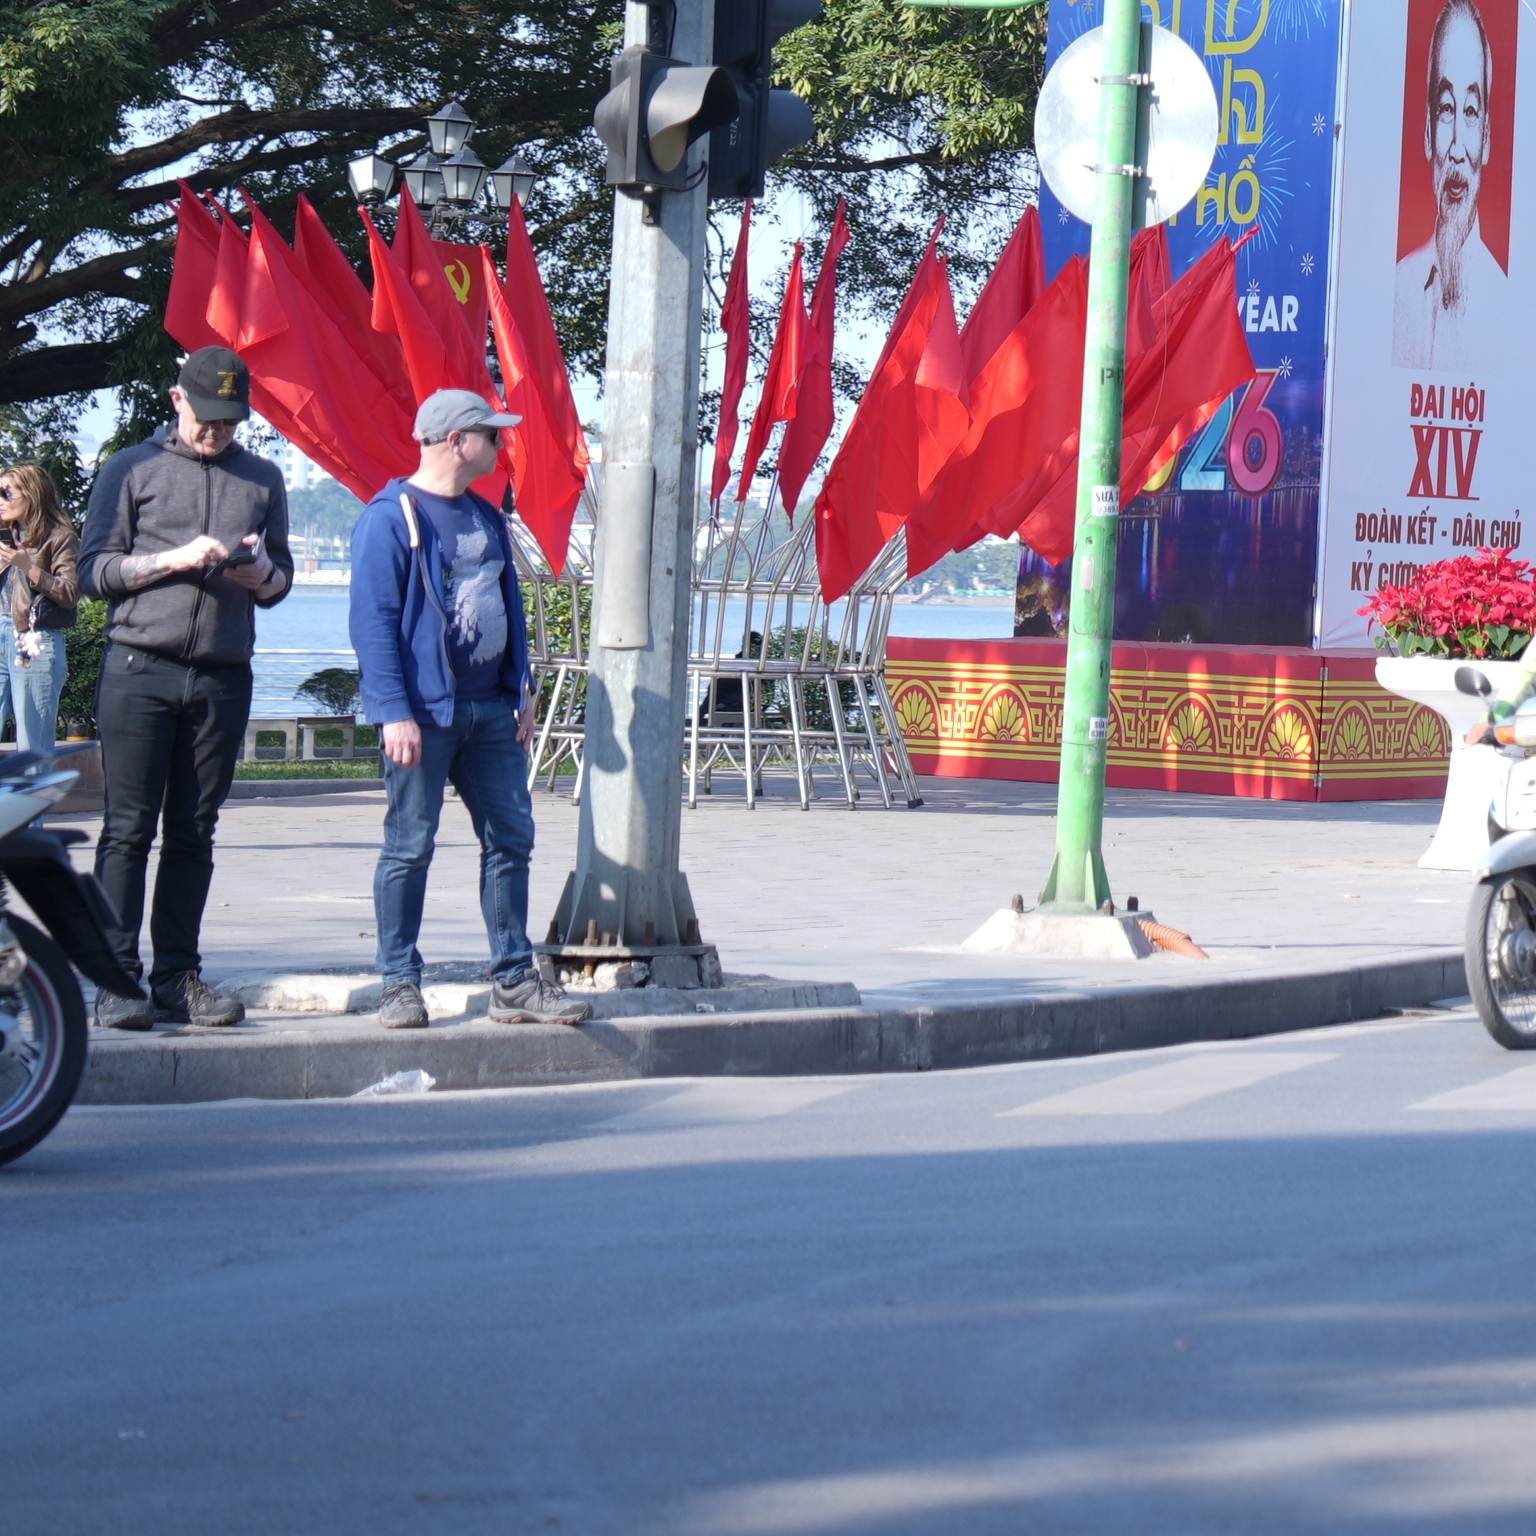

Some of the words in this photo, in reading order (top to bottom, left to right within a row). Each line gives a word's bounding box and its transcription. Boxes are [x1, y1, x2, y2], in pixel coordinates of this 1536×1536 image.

[1410, 383, 1445, 425] ĐẠI
[1451, 382, 1485, 428] HỘI
[1407, 424, 1483, 501] XIV
[1355, 508, 1402, 544] ĐOÀN
[1407, 506, 1437, 545] KẾT
[1452, 513, 1486, 547] DÂN
[1490, 509, 1521, 550] CHỦ
[1351, 549, 1373, 591] KỶ
